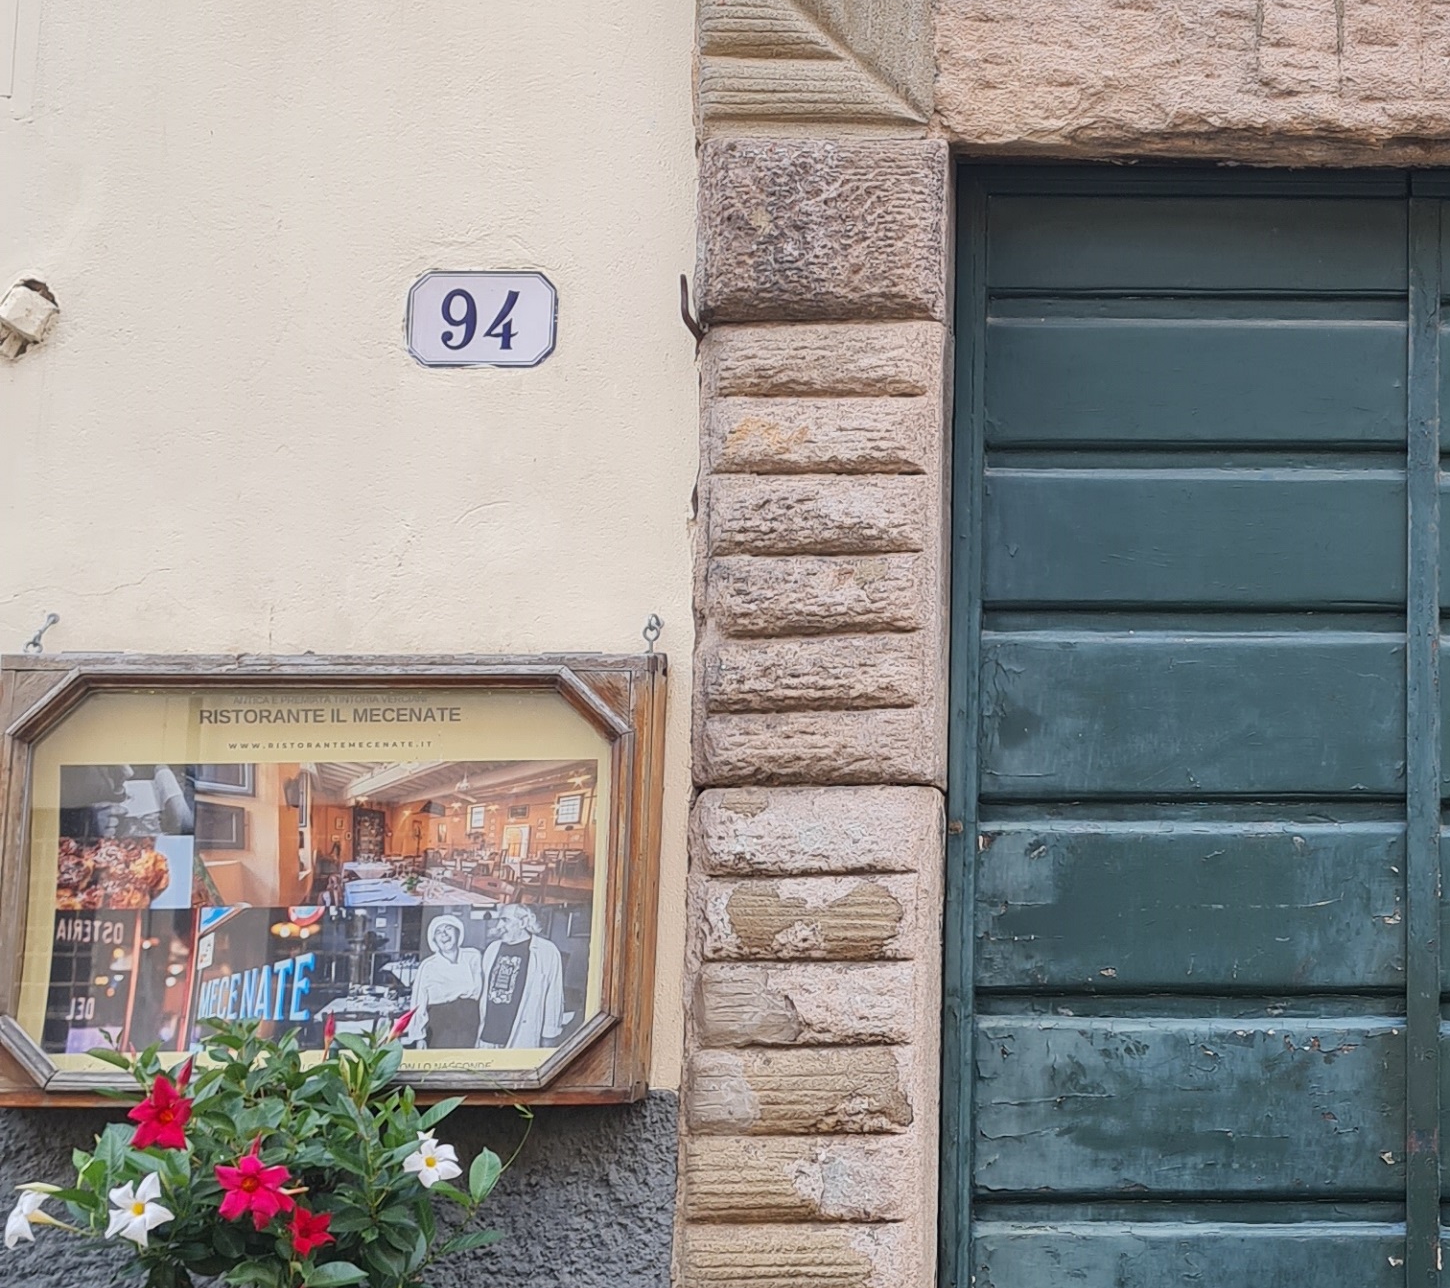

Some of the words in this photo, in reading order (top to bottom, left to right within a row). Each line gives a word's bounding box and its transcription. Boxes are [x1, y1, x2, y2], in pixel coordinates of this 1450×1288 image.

[441, 288, 520, 350] 94
[199, 708, 327, 724] RISTORANTE
[331, 708, 347, 723] IL
[353, 707, 461, 723] MECENATE
[228, 741, 432, 750] WWW.RISTORANTEMECENATE.IT
[198, 952, 316, 1021] MECENATE
